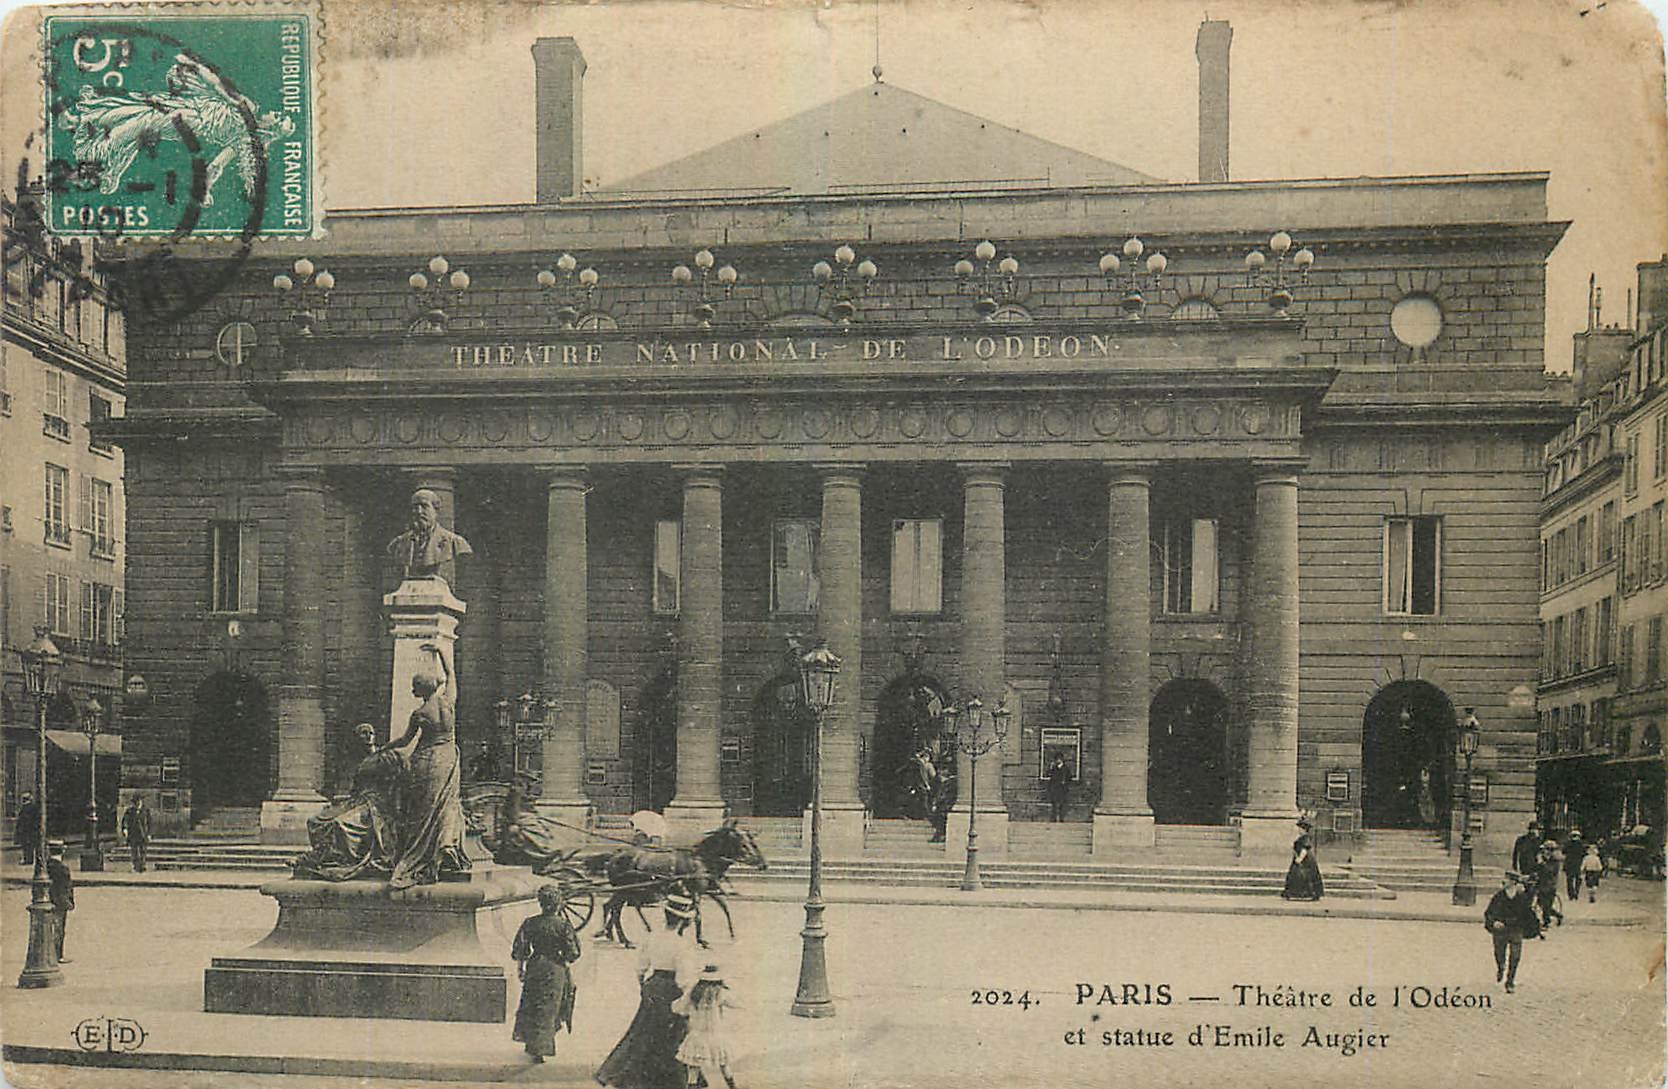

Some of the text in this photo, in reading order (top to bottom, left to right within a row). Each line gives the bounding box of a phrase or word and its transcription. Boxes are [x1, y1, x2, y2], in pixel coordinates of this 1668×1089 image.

[284, 142, 302, 227] FRANÇAISE
[63, 206, 149, 227] POSTES
[636, 337, 828, 363] NATIONAL
[863, 339, 906, 360] DE
